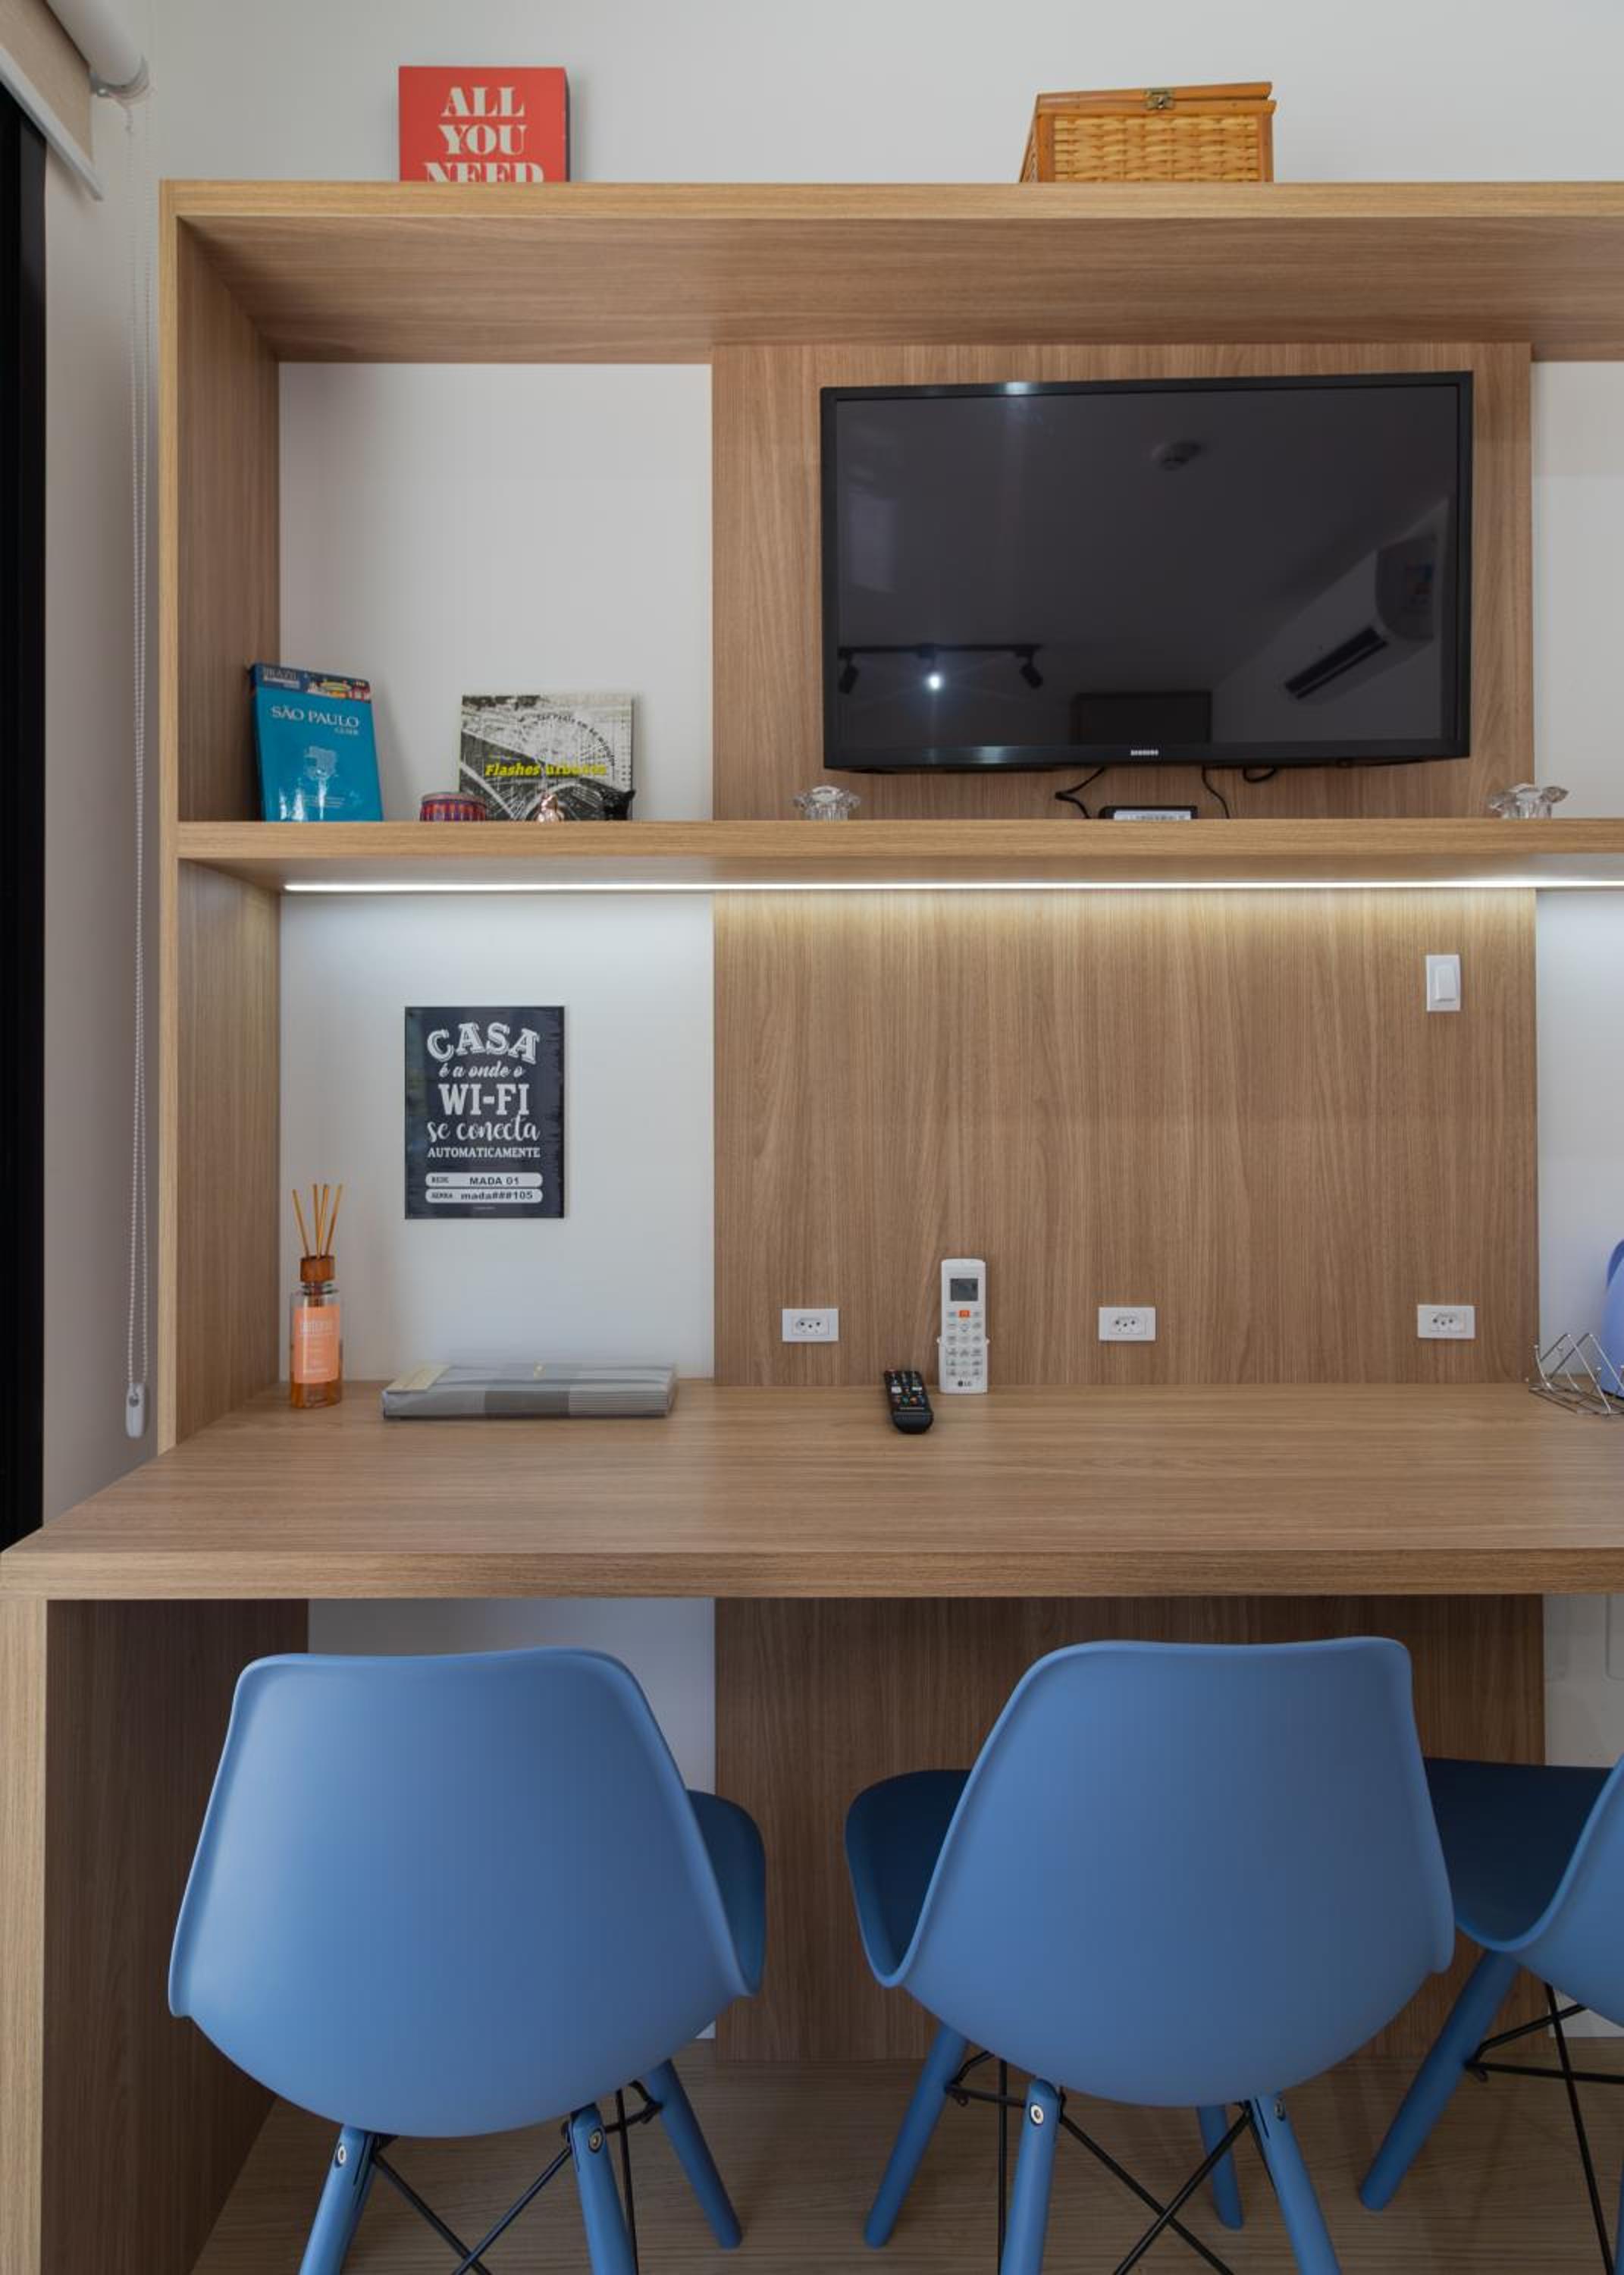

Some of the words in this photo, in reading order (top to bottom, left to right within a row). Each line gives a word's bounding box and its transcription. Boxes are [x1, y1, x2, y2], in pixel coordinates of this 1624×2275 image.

[440, 86, 525, 117] ALL
[438, 124, 526, 155] YOU
[271, 704, 304, 721] SÃO
[309, 710, 359, 728] PAULO
[484, 762, 540, 777] Flashes
[427, 1021, 541, 1065] CASA
[453, 1065, 465, 1078] a
[469, 1060, 511, 1078] onde
[513, 1065, 525, 1078] o
[437, 1083, 530, 1116] WI-FI
[427, 1121, 451, 1143] se
[456, 1113, 541, 1141] conecta
[427, 1147, 541, 1158] AUTOMATICAMENTE
[469, 1176, 503, 1185] MADA
